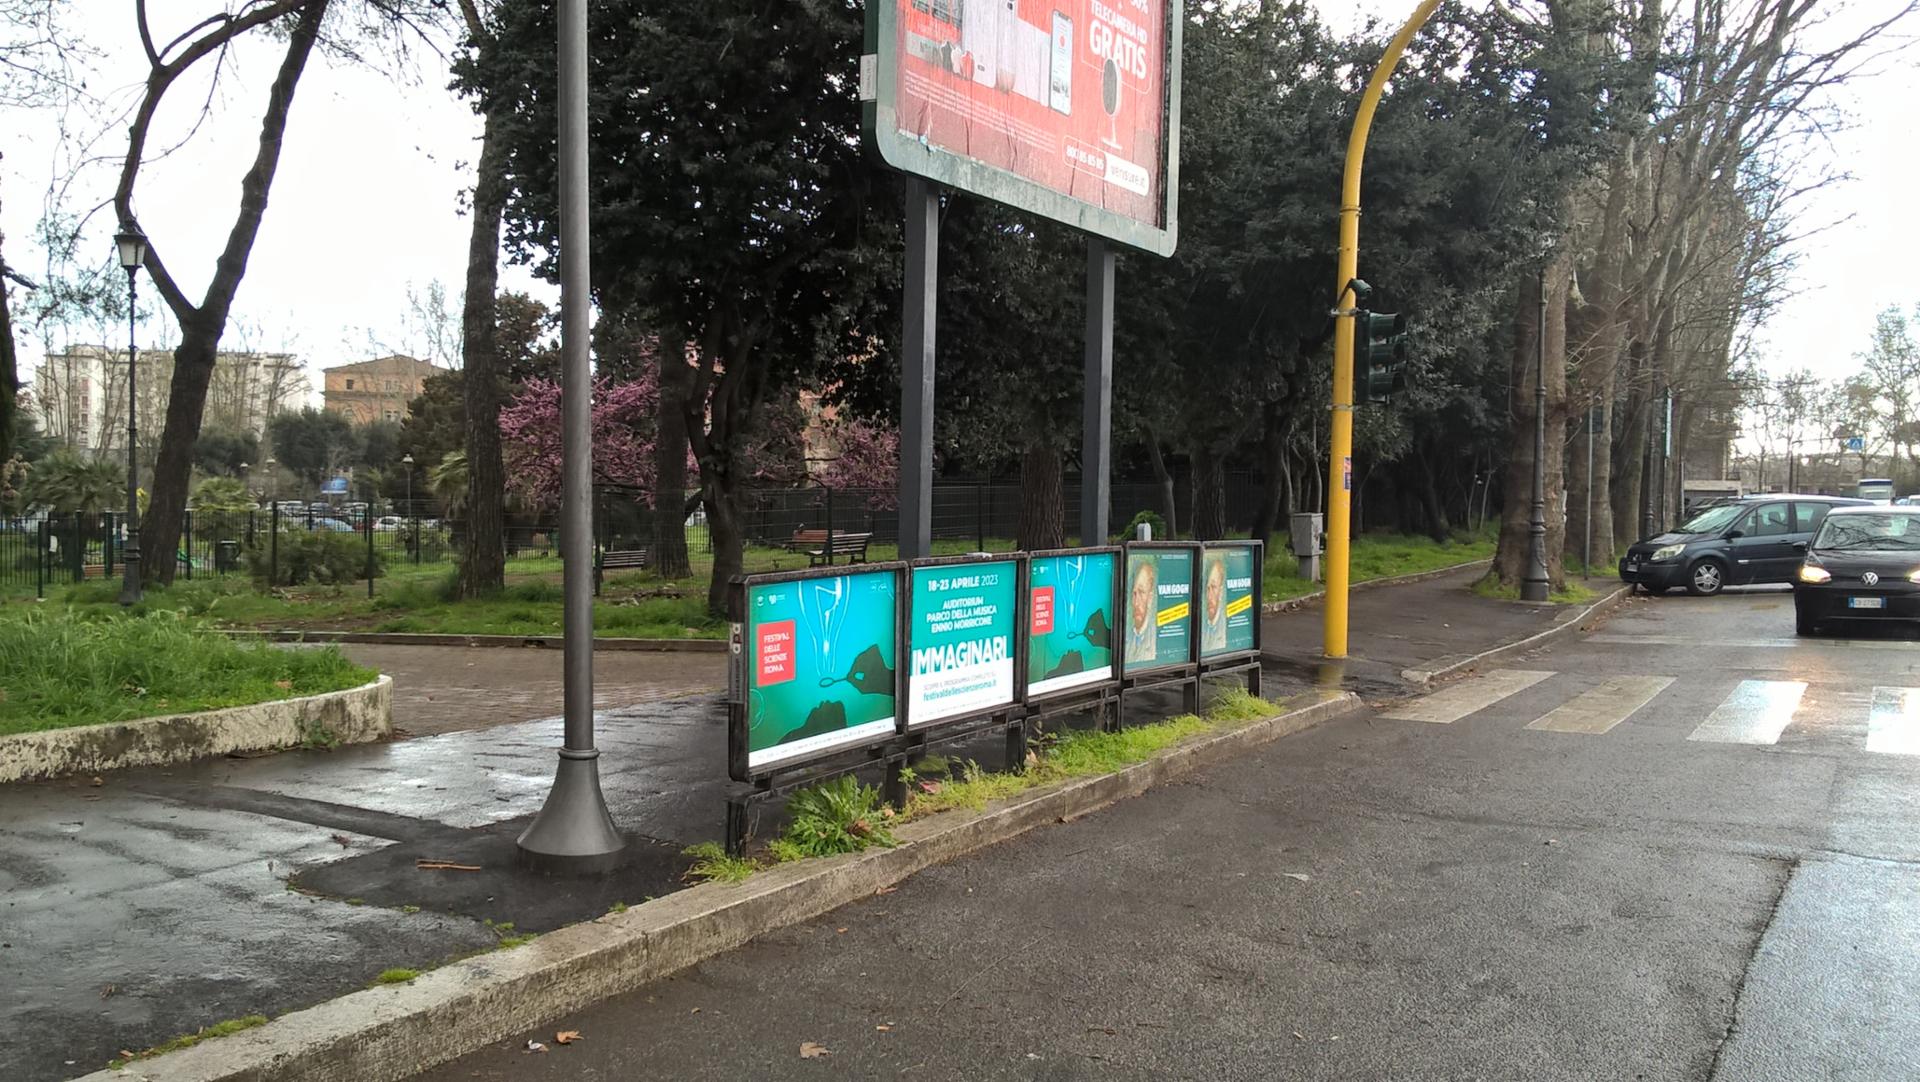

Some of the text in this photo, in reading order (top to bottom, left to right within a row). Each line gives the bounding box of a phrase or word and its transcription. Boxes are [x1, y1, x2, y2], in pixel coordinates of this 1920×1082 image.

[1090, 18, 1146, 80] GRATIS
[928, 574, 999, 592] 18-23 APRILE 2023
[1158, 583, 1189, 595] VAN GOGH
[942, 596, 984, 610] AUDITORIUM
[927, 604, 998, 623] PARCO DELLA MUSICA
[931, 615, 993, 634] ENNIO MORRICONE
[763, 632, 790, 644] FESTIVAL
[912, 635, 1007, 676] IMMAGINARI
